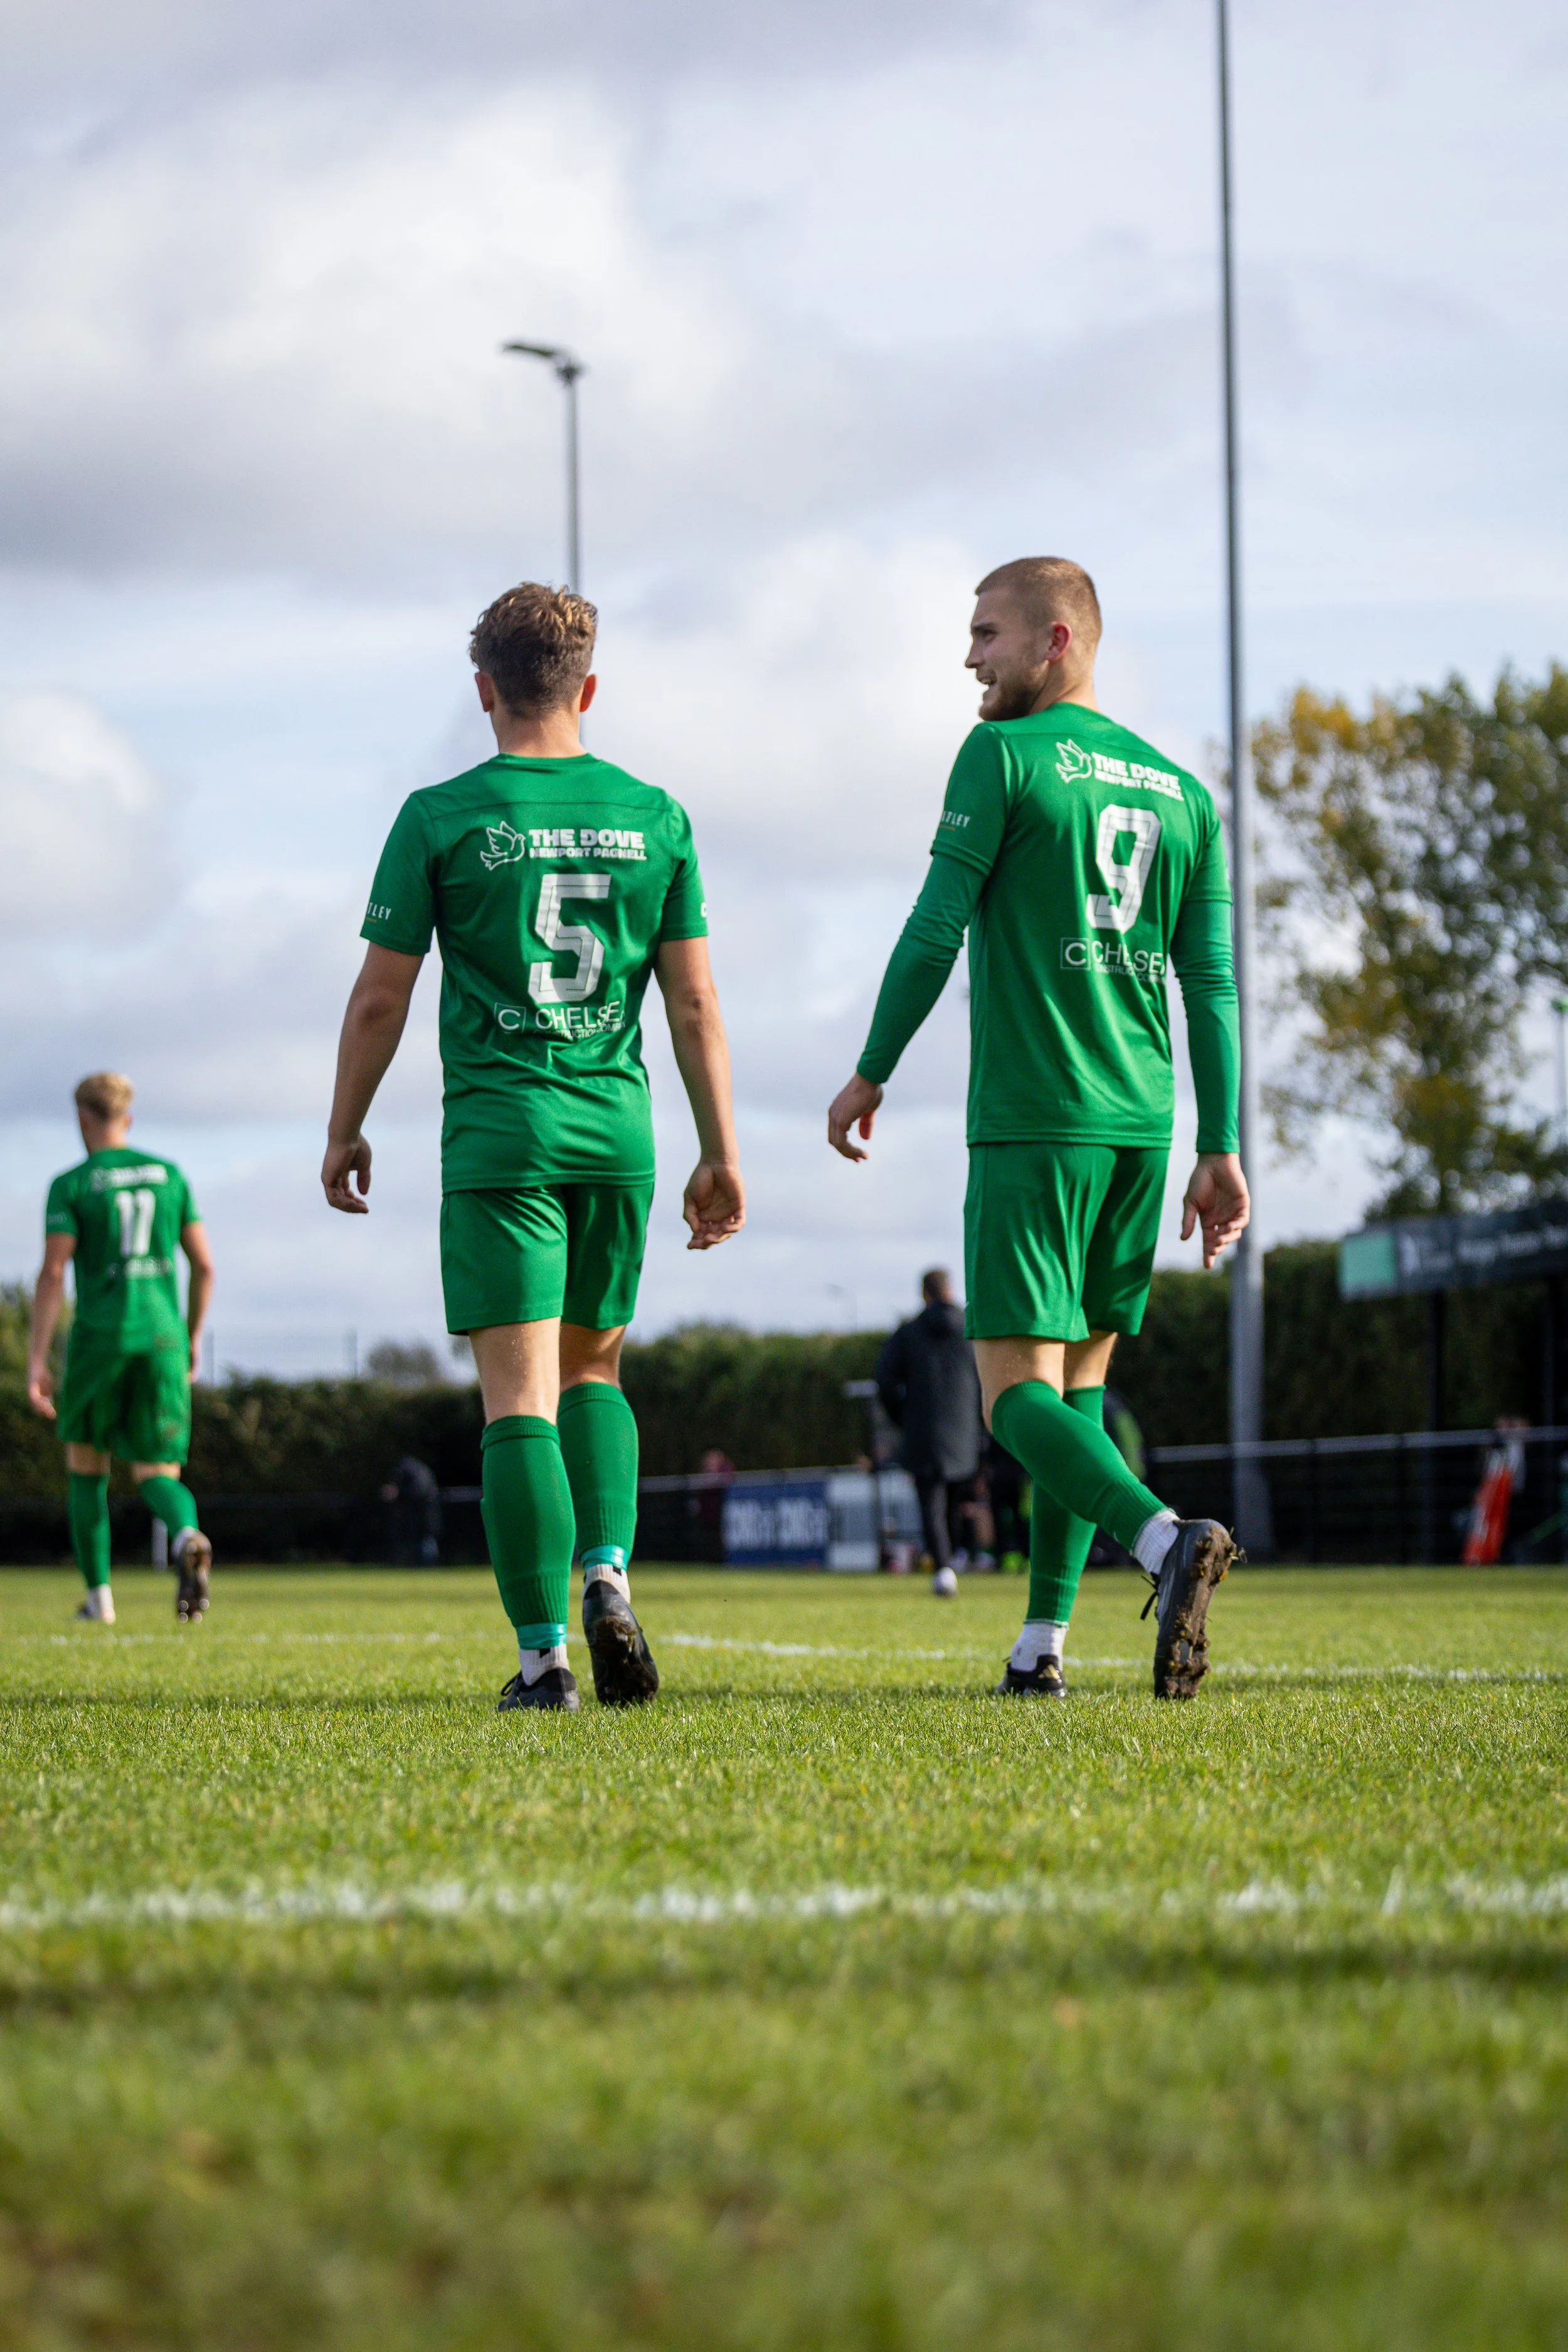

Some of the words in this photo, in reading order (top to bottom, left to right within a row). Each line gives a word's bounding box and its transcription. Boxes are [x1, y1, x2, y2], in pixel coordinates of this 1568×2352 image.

[1091, 751, 1128, 776] THE
[1130, 763, 1182, 791] DOVE
[529, 829, 575, 847] THE
[580, 829, 645, 849] DOVE
[529, 847, 591, 858] NEWPORT
[593, 847, 647, 861] PAGNELL
[1086, 804, 1162, 935] 9
[528, 873, 612, 1004] 5
[1065, 942, 1087, 967] C
[498, 1009, 521, 1030] C
